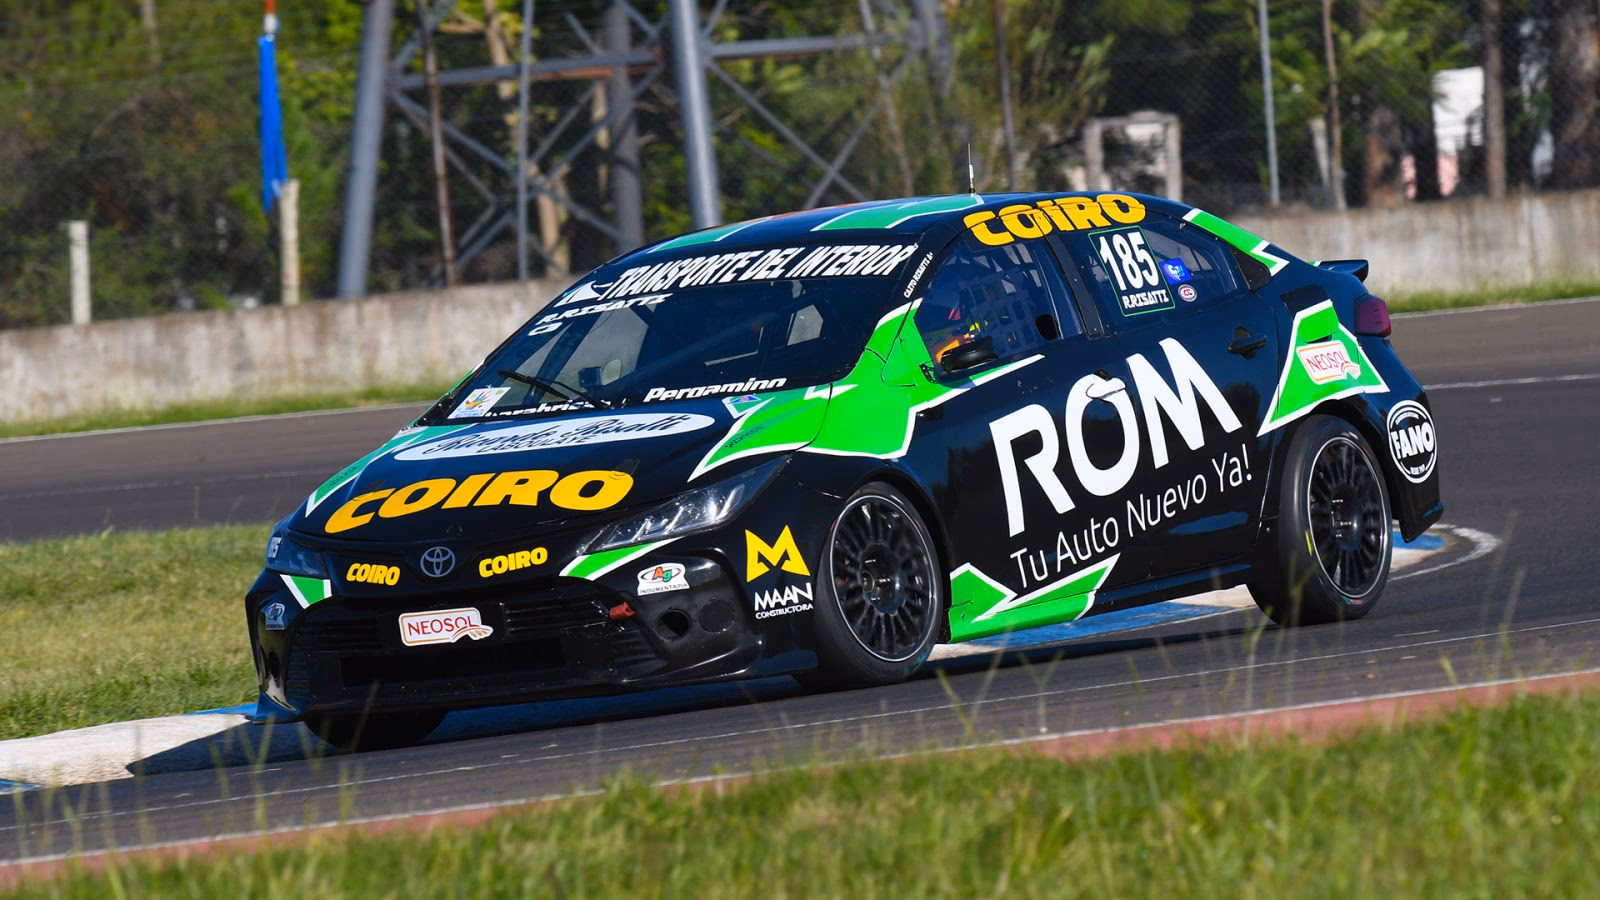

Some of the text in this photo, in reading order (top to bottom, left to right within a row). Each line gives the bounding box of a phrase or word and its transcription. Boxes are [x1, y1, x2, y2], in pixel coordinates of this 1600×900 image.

[963, 194, 1146, 246] COIRO
[597, 244, 917, 301] TRANSPORTE DEL INTERIOR
[913, 257, 931, 282] RISATTI
[1099, 231, 1159, 291] 185
[1306, 351, 1351, 373] NEOSOL
[559, 415, 692, 439] Risatti
[988, 337, 1243, 538] ROM
[1390, 421, 1434, 460] FANO
[476, 434, 598, 454] LABOULAYE
[324, 470, 634, 534] COIRO
[1010, 443, 1252, 588] Tu Auto Nuevo Ya!
[345, 562, 401, 586] COIRO
[478, 547, 548, 578] COIRO
[754, 582, 814, 611] MAAN
[755, 603, 814, 620] CONSTRUCTORA
[407, 614, 477, 637] NEOSOL
